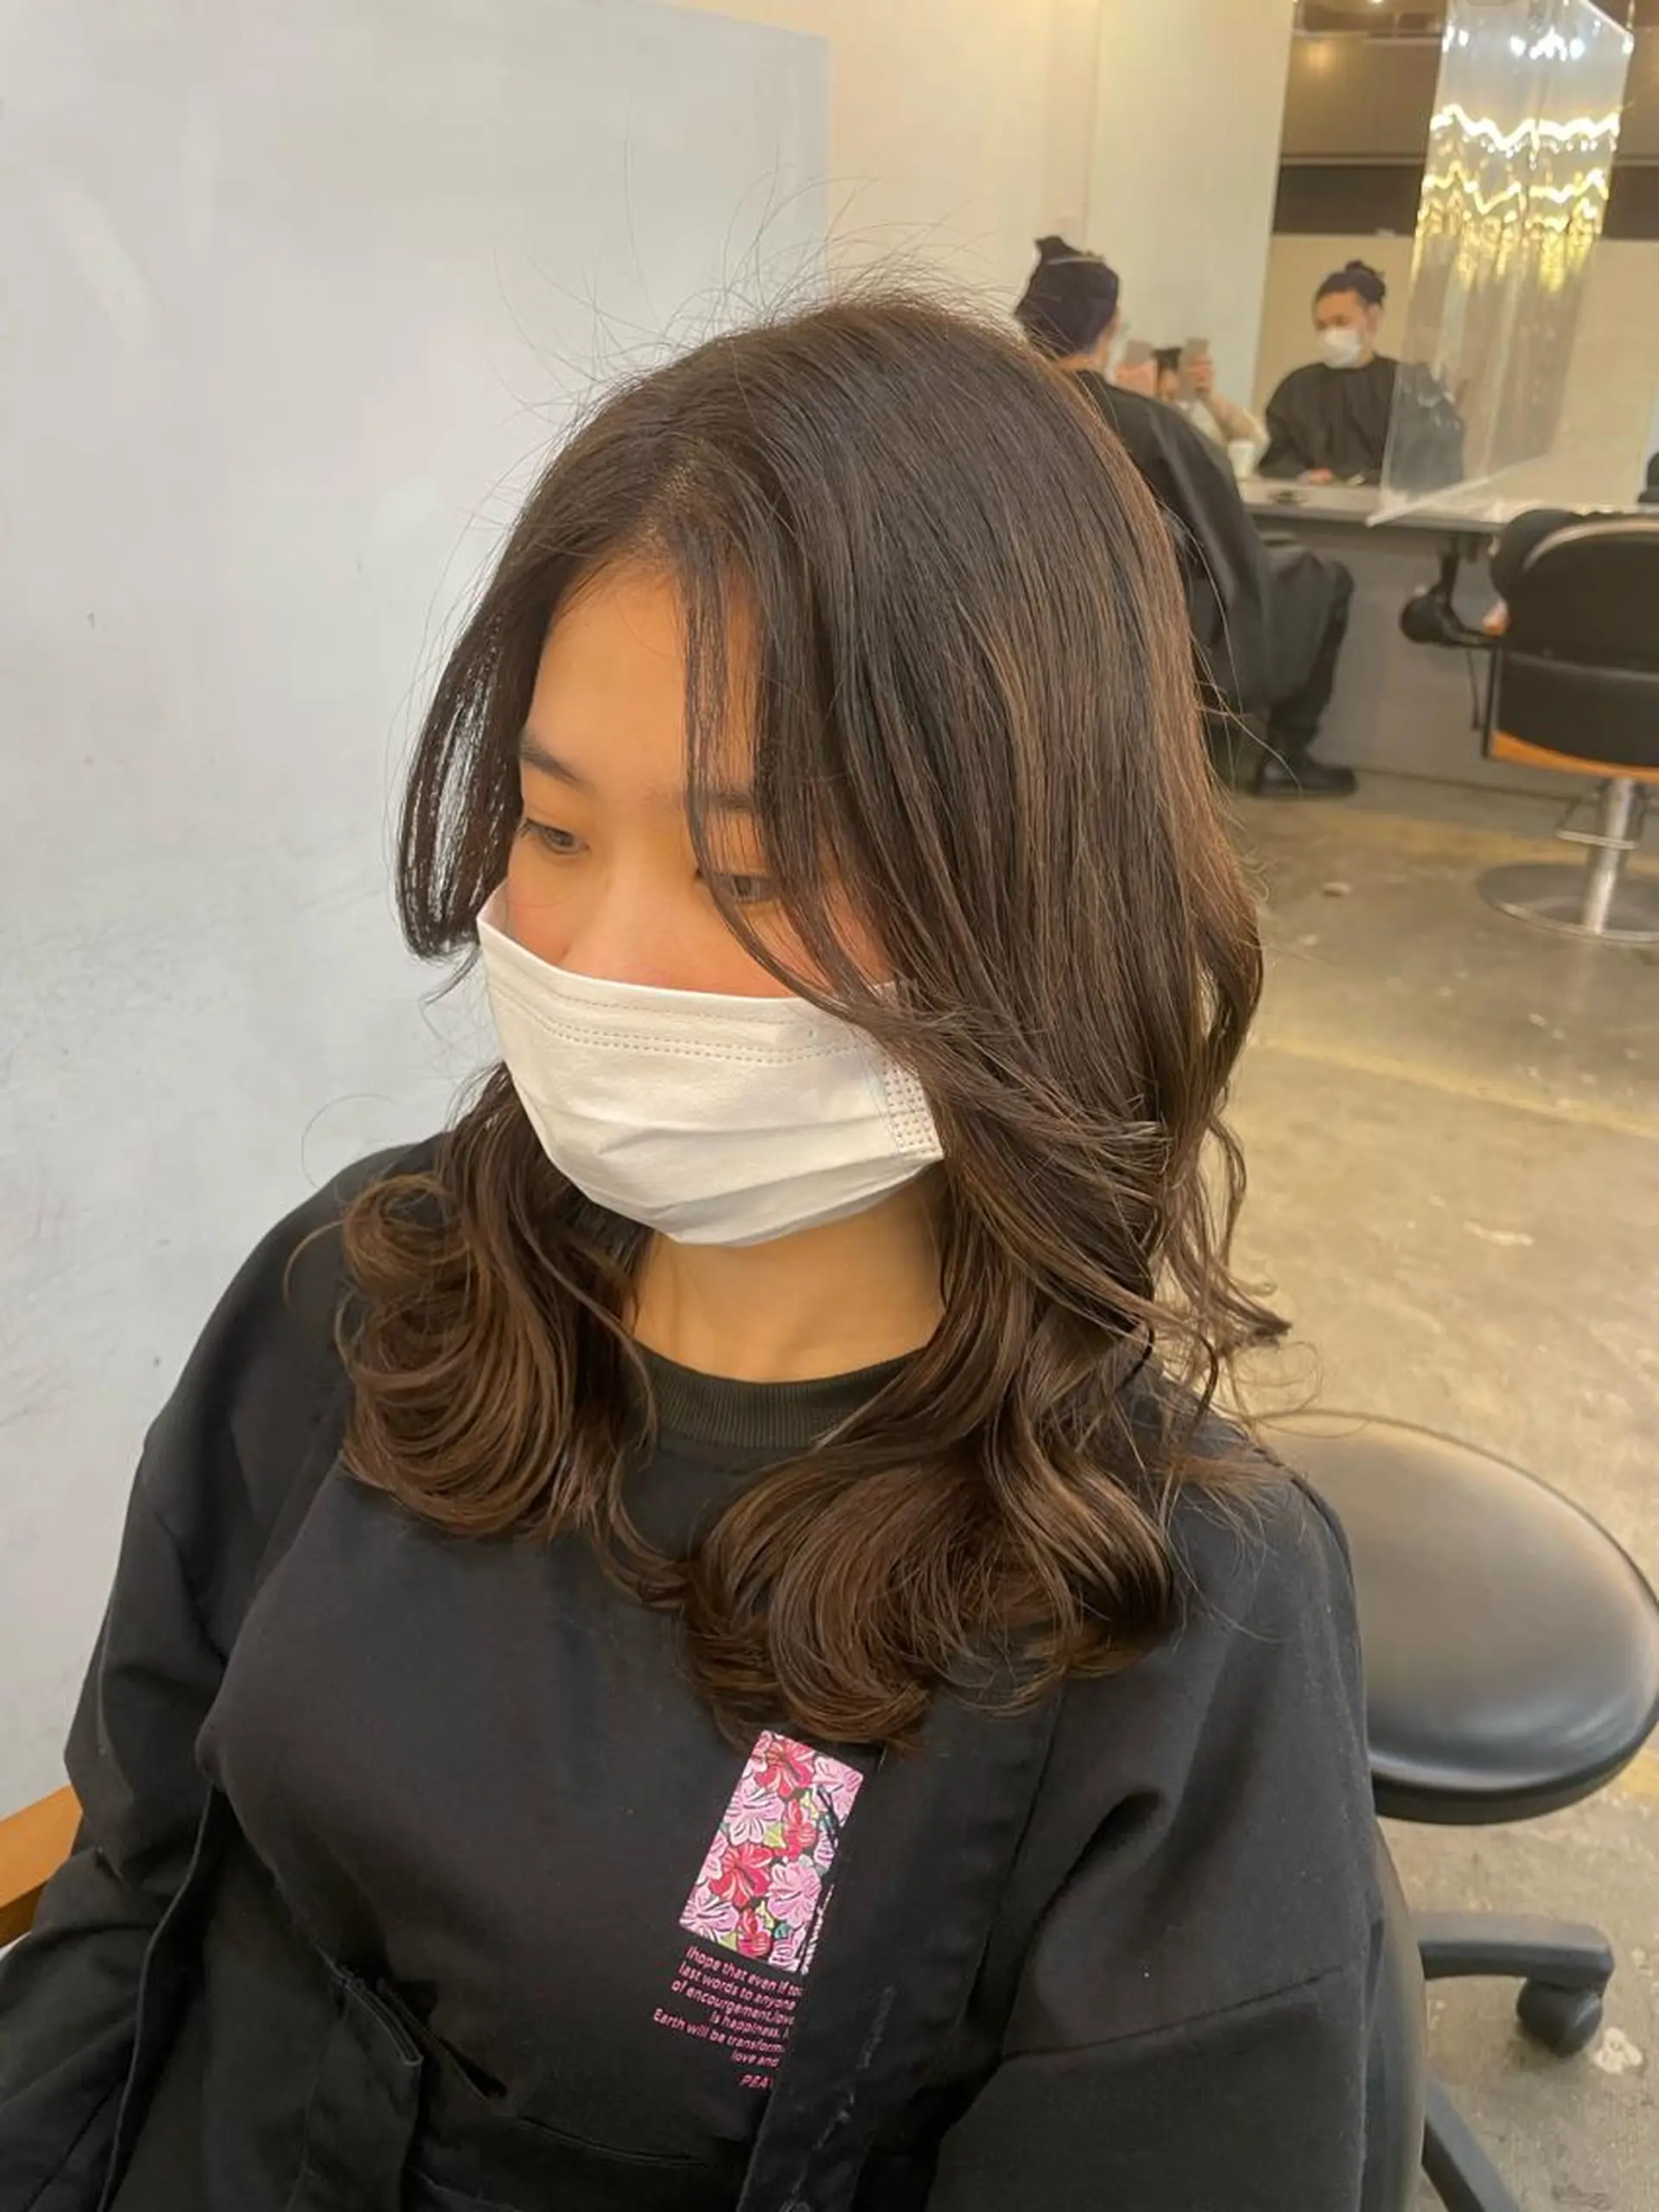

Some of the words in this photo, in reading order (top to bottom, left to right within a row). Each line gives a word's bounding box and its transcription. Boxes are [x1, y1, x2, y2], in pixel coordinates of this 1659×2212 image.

[671, 1980, 688, 1993] of
[678, 1961, 702, 1981] last
[702, 1974, 738, 1996] words
[739, 1987, 753, 2001] to
[753, 1993, 796, 2011] anyone
[722, 1962, 747, 1981] that
[748, 1974, 778, 1991] even
[653, 2008, 686, 2031] Earth
[687, 2023, 709, 2037] will
[709, 2030, 726, 2044] be
[732, 2049, 757, 2065] love
